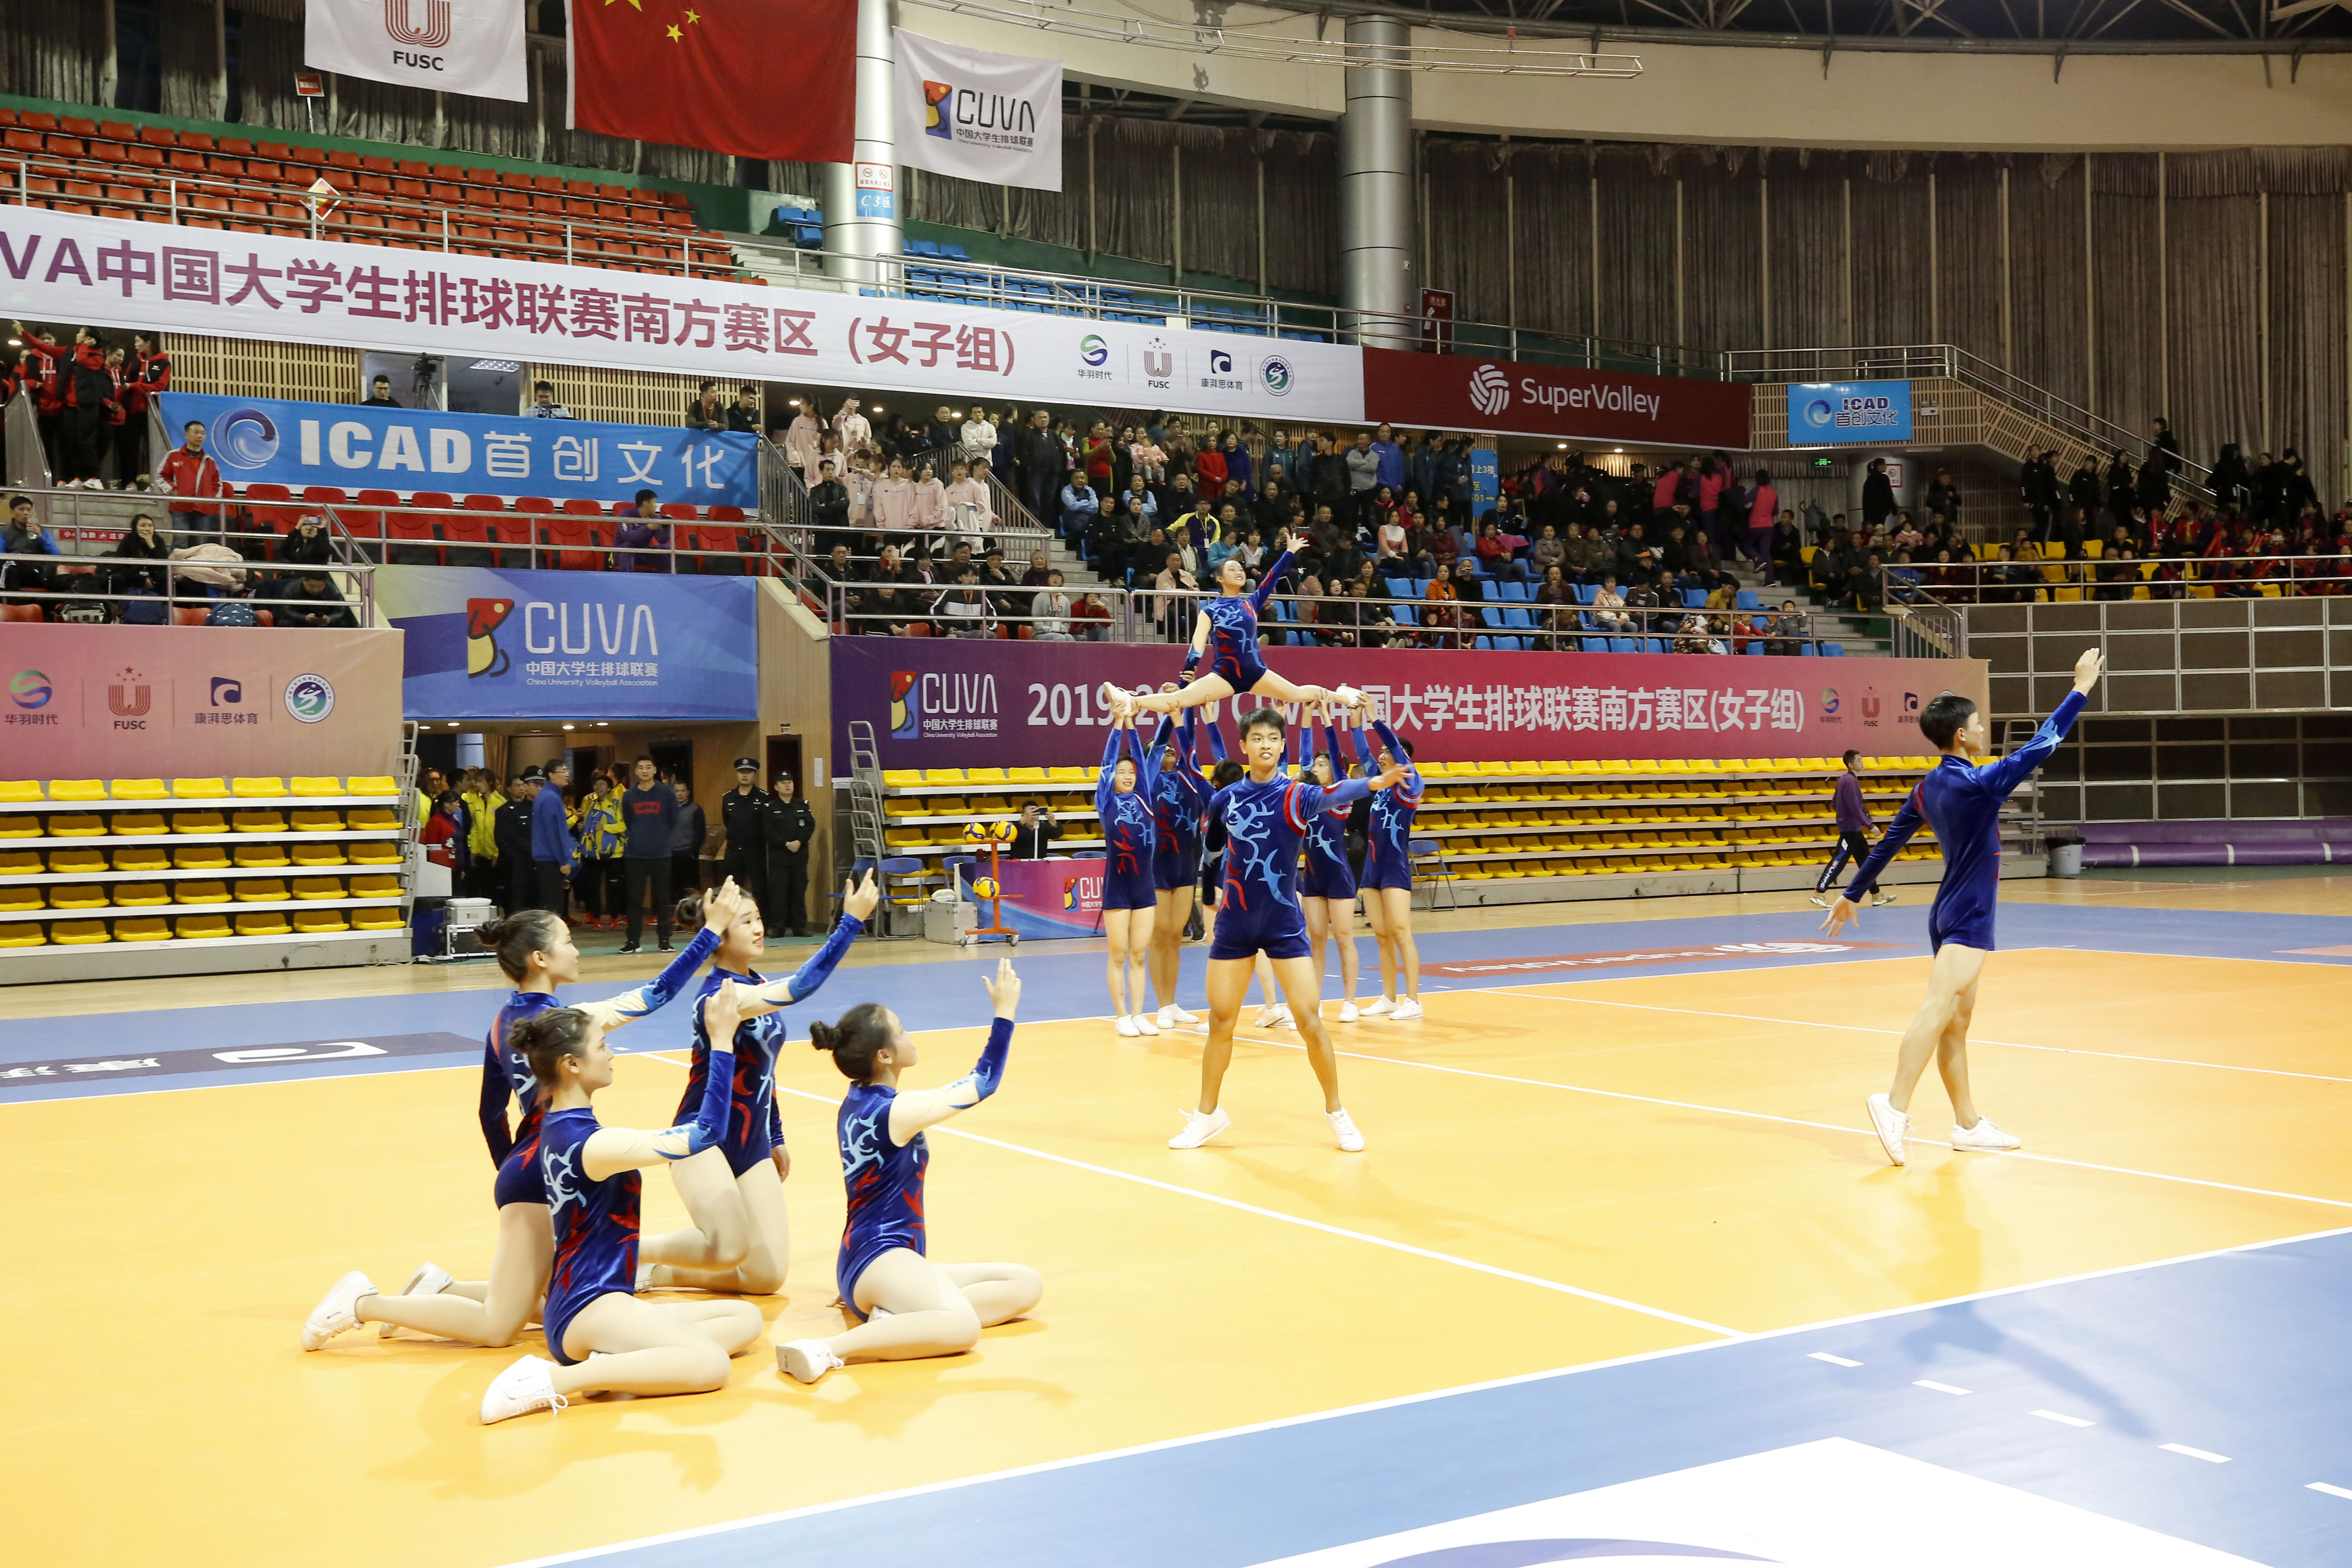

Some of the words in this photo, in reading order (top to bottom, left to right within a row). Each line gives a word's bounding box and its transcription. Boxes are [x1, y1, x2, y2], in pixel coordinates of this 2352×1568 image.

[393, 50, 444, 71] FUSC
[957, 89, 1035, 133] CUVA
[956, 128, 1033, 147] 中国大学生排球联赛
[1077, 369, 1112, 380] 华羽时代
[1148, 380, 1170, 389] FUSC
[1201, 379, 1243, 391] 康湃思体育
[1521, 378, 1660, 421] SuperVolley
[1842, 398, 1890, 411] ICAD
[1835, 410, 1898, 427] 首创文化
[301, 419, 471, 475] ICAD
[485, 431, 726, 490] 首创文化
[525, 602, 658, 655] CUVA
[526, 661, 658, 677] 中国大学生排球联赛
[548, 678, 584, 687] University
[585, 679, 617, 687] Volleyball
[923, 673, 998, 714] CUVA
[5, 714, 59, 725] 华羽时代
[114, 721, 146, 729] FUSC
[195, 713, 259, 724] 康湃思体育
[923, 719, 998, 731] 中国大学生排球联赛
